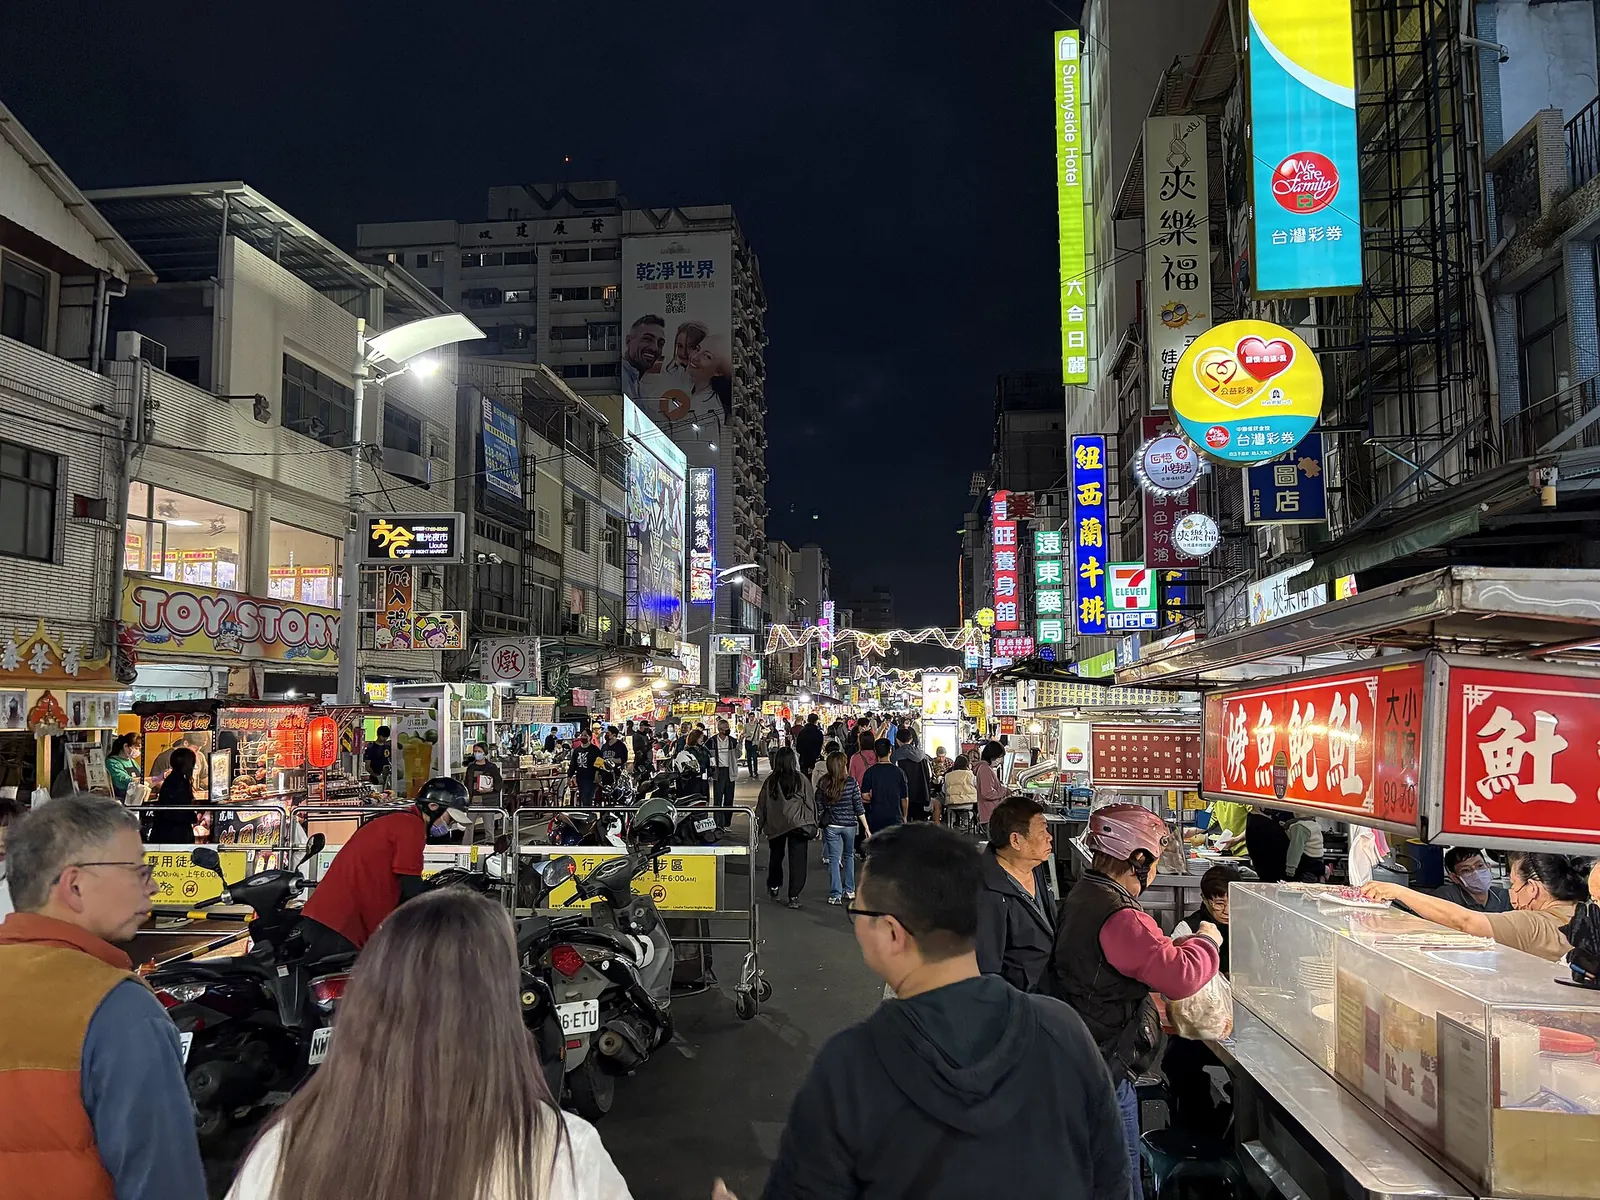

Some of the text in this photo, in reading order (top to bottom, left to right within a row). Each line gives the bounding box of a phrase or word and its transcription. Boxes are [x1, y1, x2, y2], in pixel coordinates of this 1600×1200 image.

[1061, 64, 1079, 186] Sunnyside Hotel
[1292, 160, 1315, 172] We
[1303, 170, 1322, 180] are
[1158, 165, 1198, 291] 夾樂福
[1271, 225, 1343, 245] 台灣彩券
[636, 260, 715, 281] 乾淨世界
[1066, 280, 1086, 373] 六合日麗
[1220, 386, 1254, 396] 公益彩券
[1236, 431, 1296, 447] 台灣彩券
[1150, 452, 1173, 464] 回憶
[692, 472, 711, 548] 葡京娛樂城
[1075, 445, 1105, 625] 紐西蘭牛排
[1177, 530, 1217, 542] 夾樂福
[1037, 533, 1062, 642] 遠東藥局
[132, 586, 340, 650] TOY STORY
